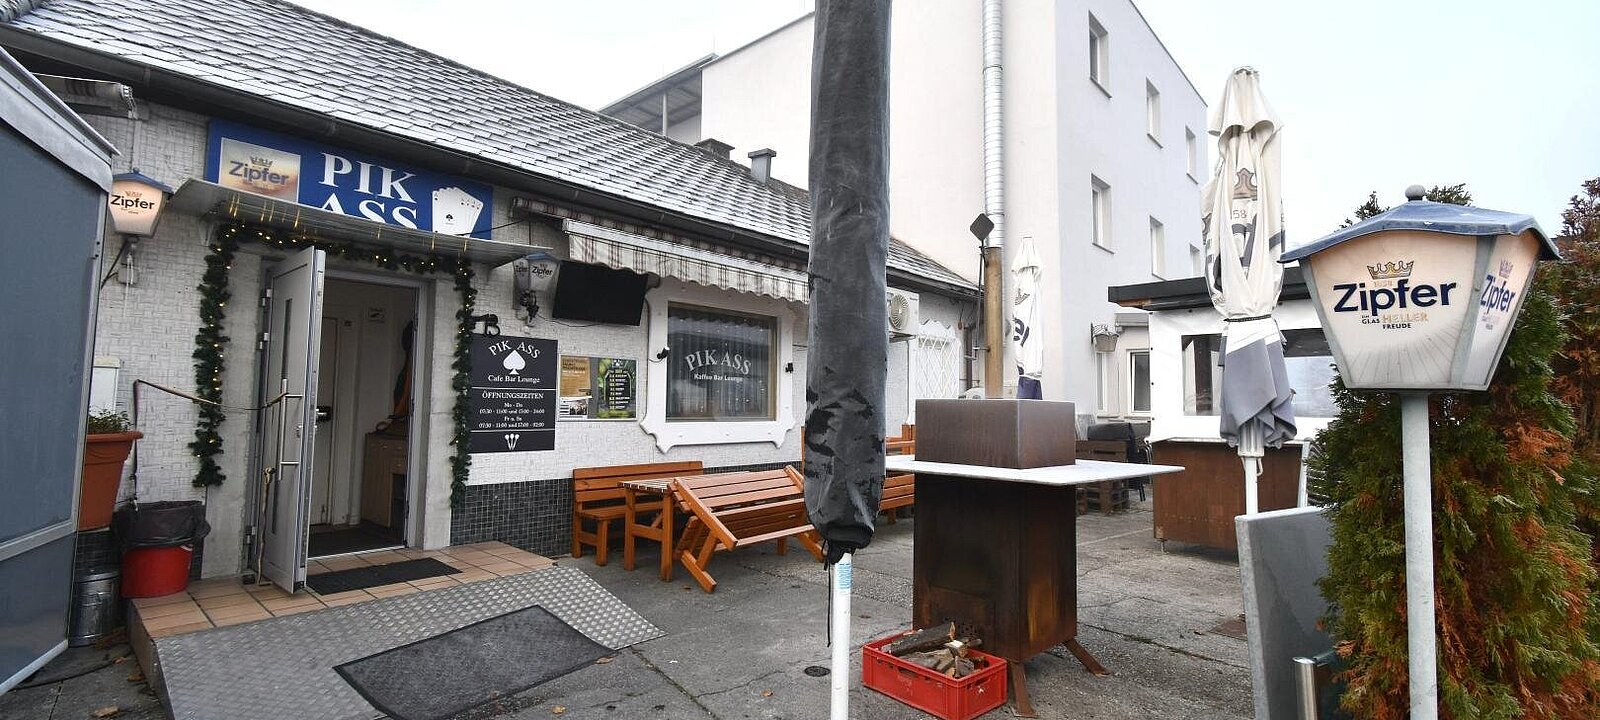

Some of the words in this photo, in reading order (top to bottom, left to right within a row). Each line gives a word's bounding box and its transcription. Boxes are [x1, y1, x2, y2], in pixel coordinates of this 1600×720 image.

[229, 160, 290, 186] Zipfer
[319, 153, 417, 204] PIK
[110, 194, 155, 209] Zipfer
[320, 192, 417, 230] ASS
[531, 264, 554, 277] Zipfer
[1332, 278, 1457, 317] Zipfer
[1479, 274, 1517, 314] Zipfer
[1382, 312, 1429, 324] HELLER
[488, 340, 512, 356] PIK
[517, 341, 541, 359] ASS
[684, 349, 718, 372] PIK
[721, 350, 752, 375] ASS
[518, 376, 541, 385] Lounge
[481, 390, 545, 400] ÖFFNUNGSZEITEN
